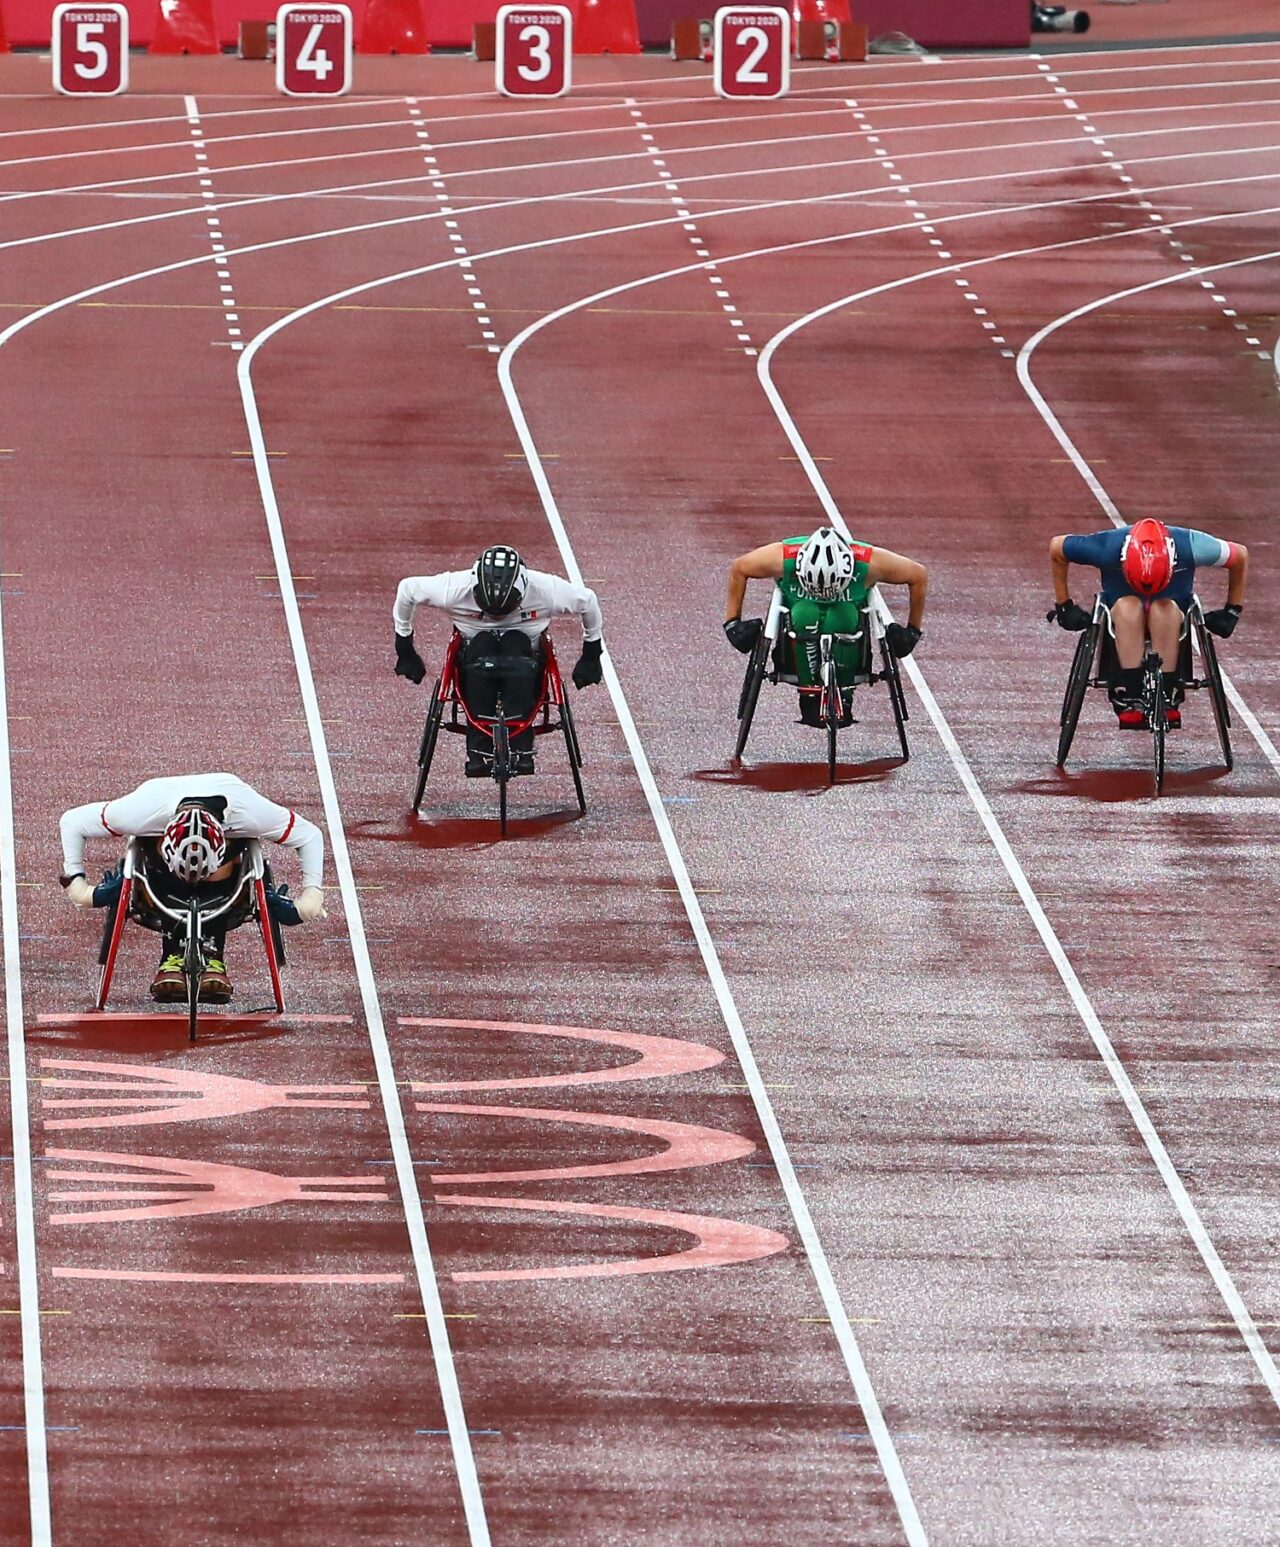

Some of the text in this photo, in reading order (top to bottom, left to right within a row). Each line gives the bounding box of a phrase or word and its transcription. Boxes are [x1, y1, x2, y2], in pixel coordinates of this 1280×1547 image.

[65, 13, 118, 22] TOKYO 2020
[289, 14, 342, 23] TOKYO 2020
[509, 15, 562, 24] TOKYO 2020
[726, 16, 779, 25] TOKYO 2020
[73, 23, 108, 79] 5
[296, 23, 333, 80] 4
[517, 25, 551, 81] 3
[736, 26, 769, 83] 2
[842, 553, 852, 574] 3
